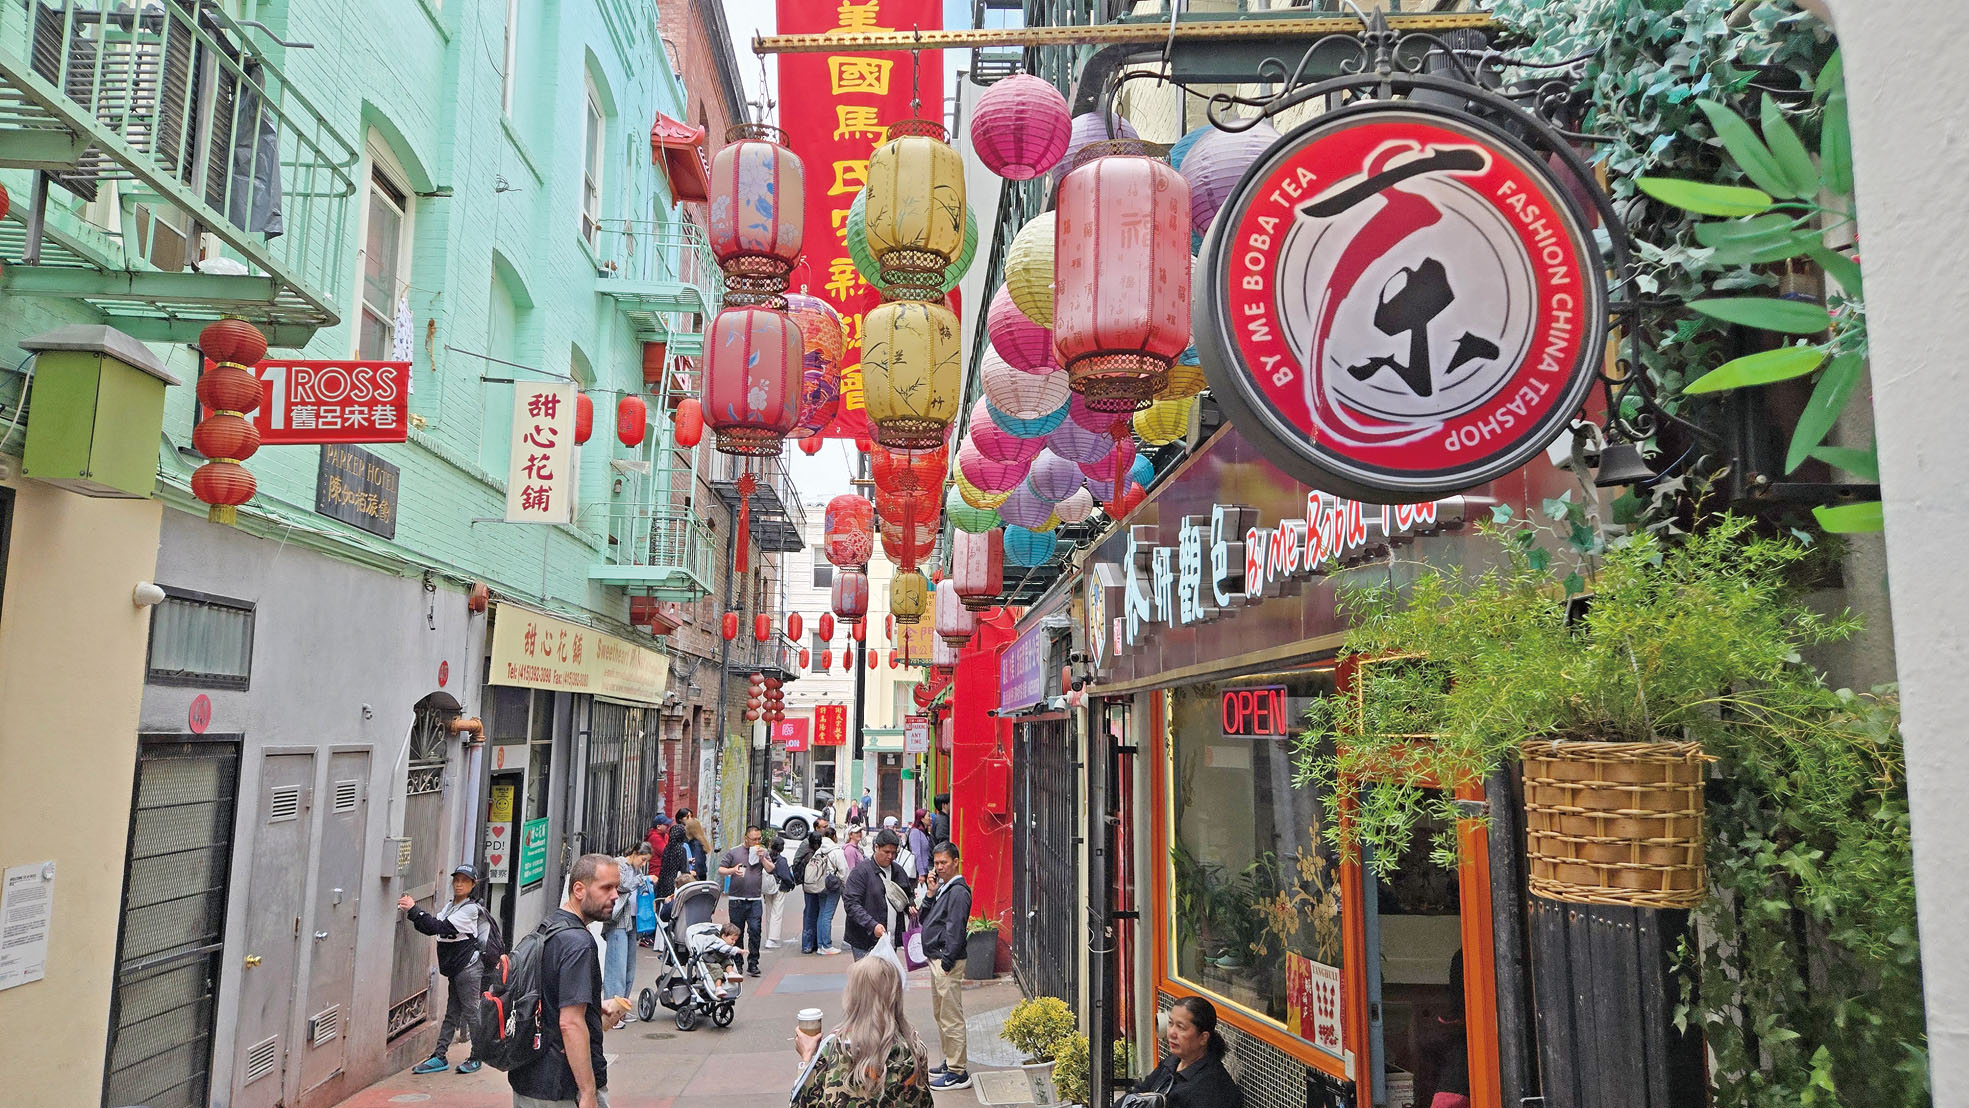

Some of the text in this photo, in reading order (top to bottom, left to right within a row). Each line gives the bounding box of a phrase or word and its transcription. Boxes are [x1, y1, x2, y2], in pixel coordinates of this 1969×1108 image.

[1242, 167, 1318, 388] BY ME BOBA TEA
[1444, 179, 1574, 452] FASHION CHINA TEASHOP
[291, 367, 398, 402] ROSS
[290, 404, 397, 430] 舊呂宋巷
[326, 444, 397, 494] PARKER HOTEL
[521, 392, 561, 513] 甜心花舖
[1223, 689, 1286, 735] OPEN
